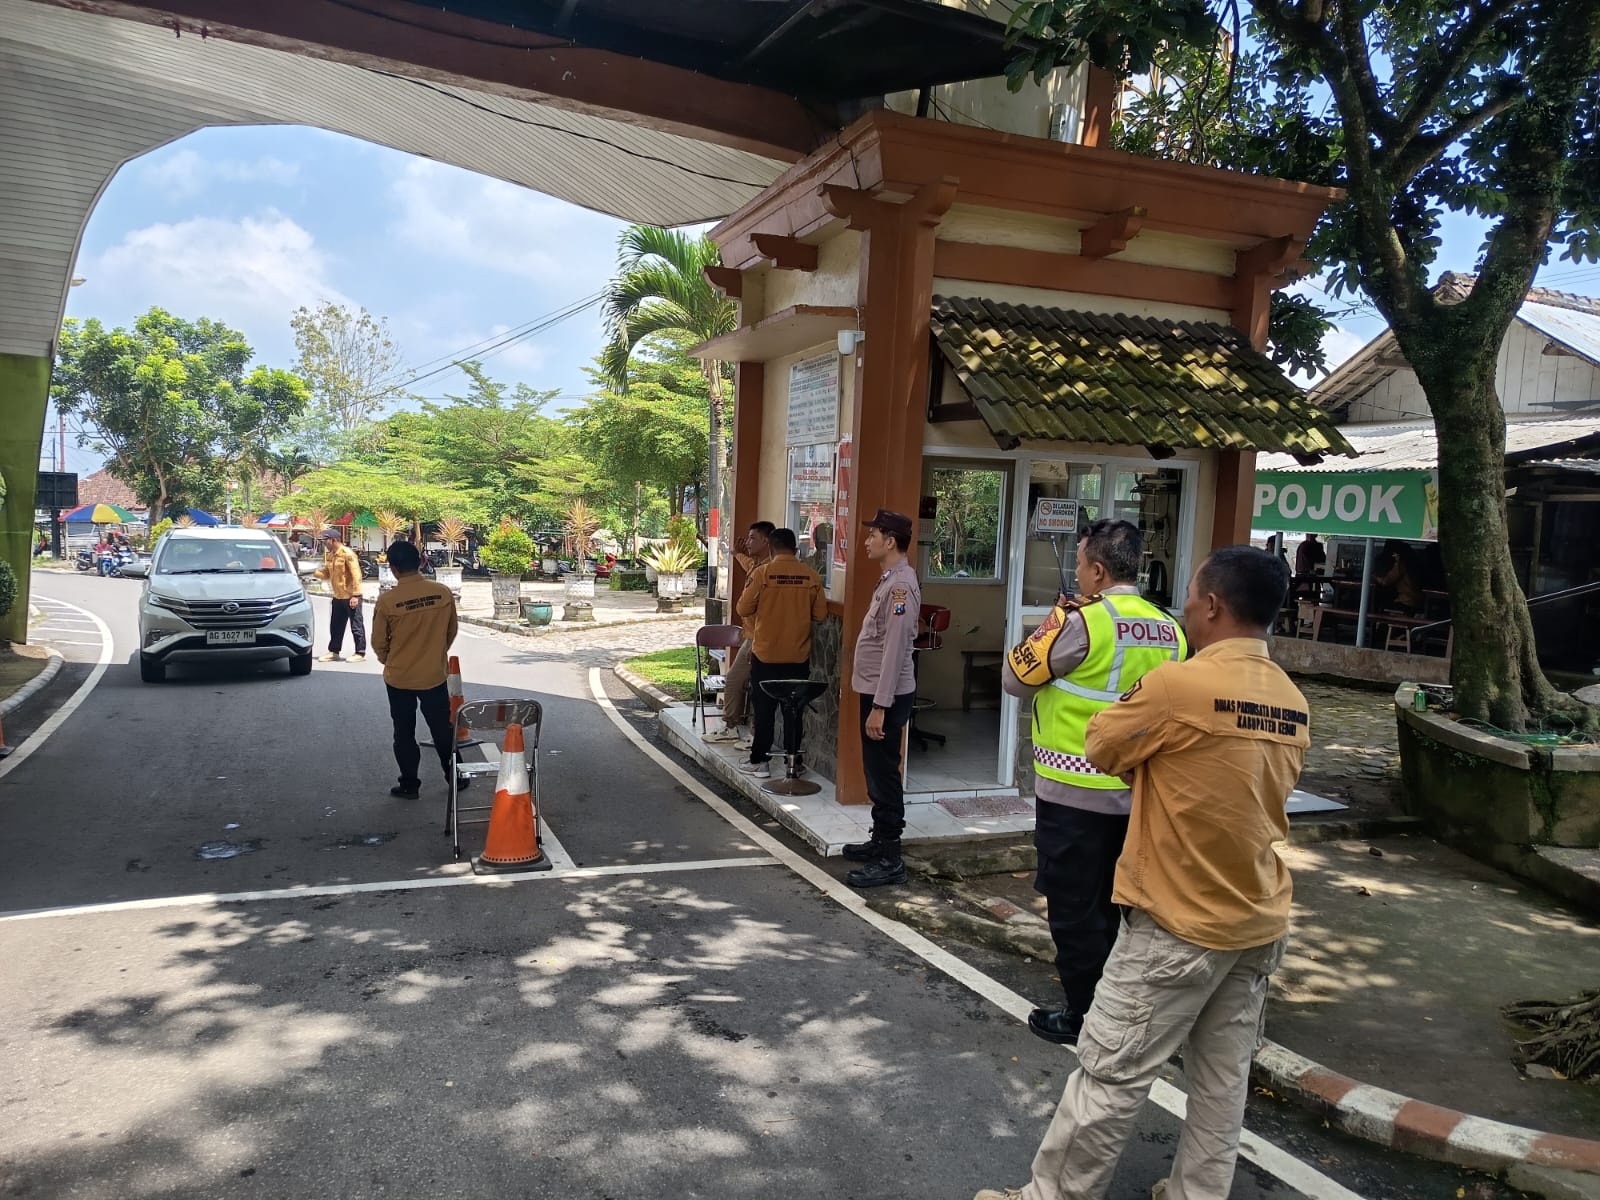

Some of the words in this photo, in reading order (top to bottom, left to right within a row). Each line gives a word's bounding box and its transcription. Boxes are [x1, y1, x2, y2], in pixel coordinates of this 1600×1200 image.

[1253, 483, 1405, 523] POJOK
[1039, 518, 1048, 526] NO
[1048, 519, 1074, 527] SMOKING
[209, 631, 220, 640] AG
[221, 631, 240, 640] 1627
[1116, 622, 1178, 642] POLISI
[1237, 715, 1276, 733] KABUPATEN
